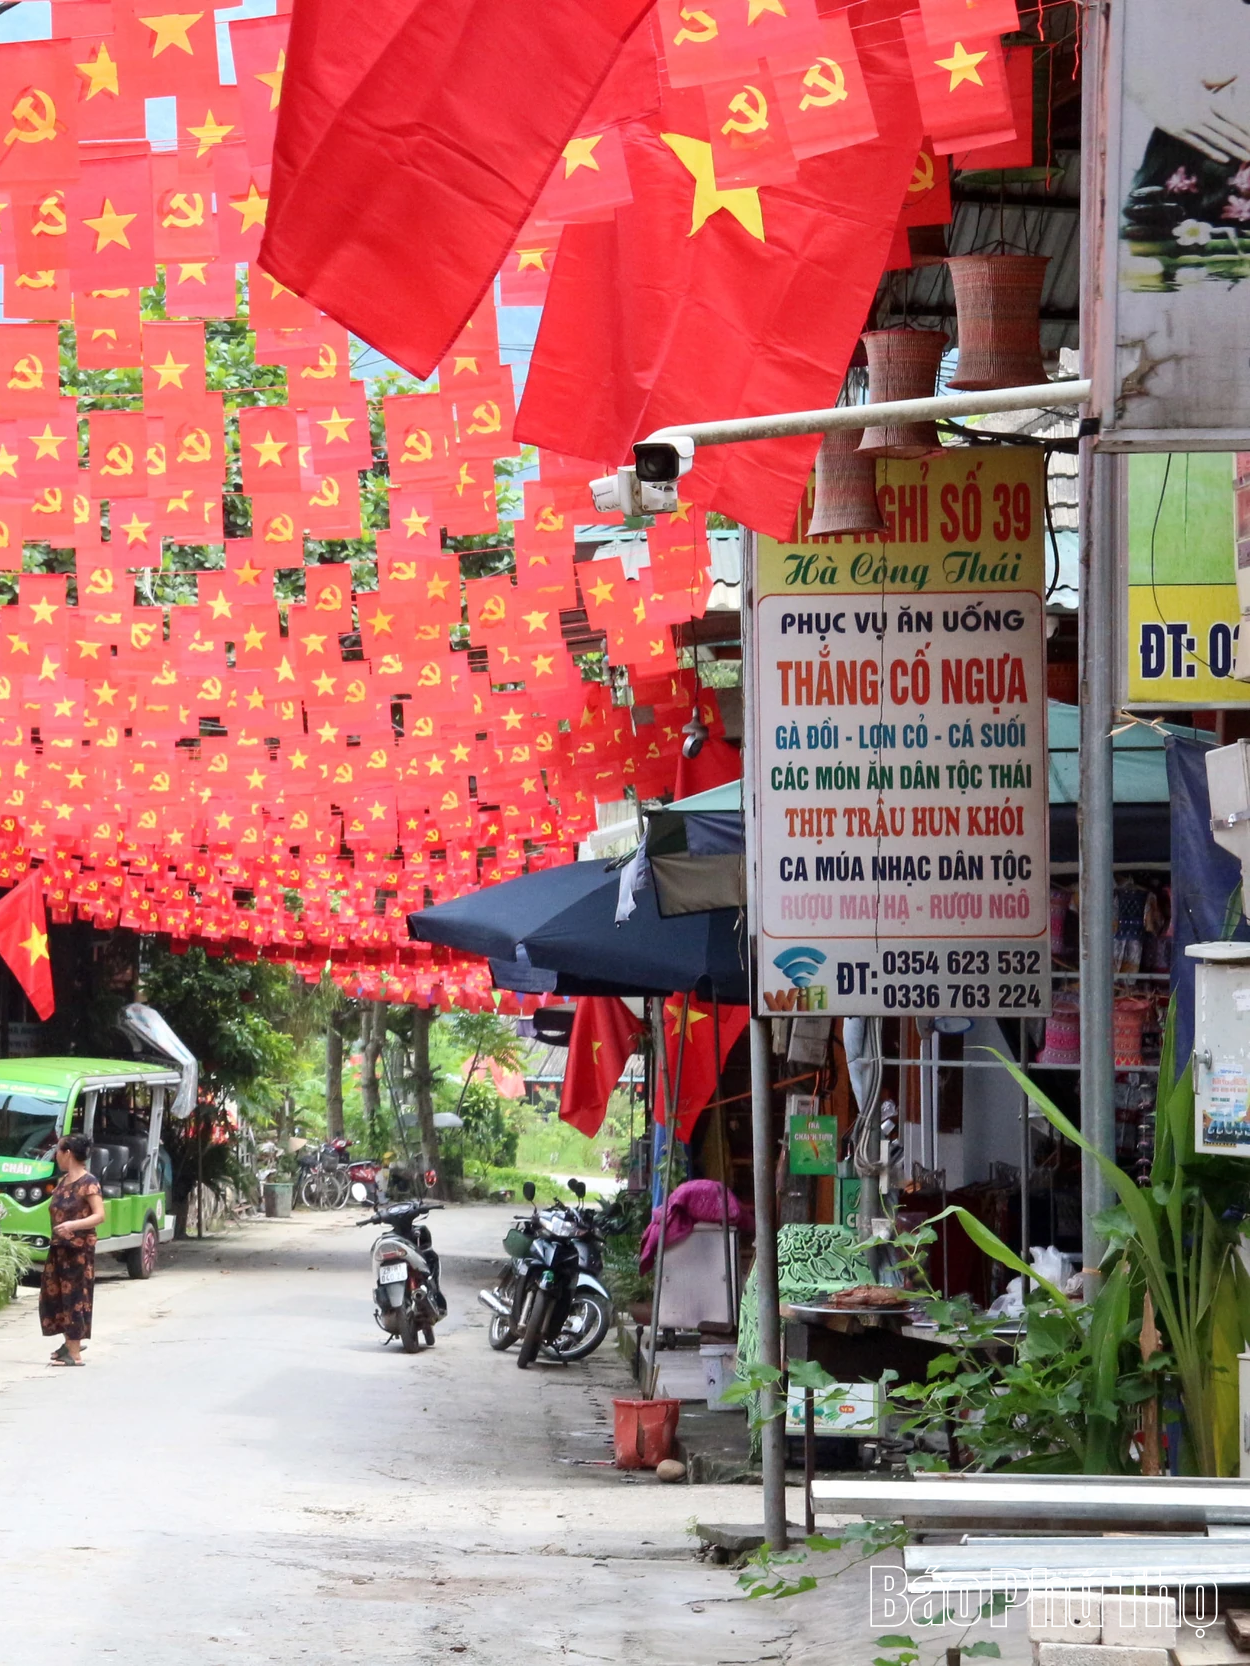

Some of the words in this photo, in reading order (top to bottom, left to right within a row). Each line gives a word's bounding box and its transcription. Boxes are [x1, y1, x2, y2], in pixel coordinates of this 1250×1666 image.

[860, 461, 929, 545] GHỈ
[940, 461, 982, 543] SỐ
[993, 482, 1031, 542] 39
[784, 553, 840, 586] Hà
[850, 552, 932, 592] Công
[943, 551, 1022, 584] Thái
[781, 612, 846, 641] PHỤC
[854, 612, 888, 641] VỤ
[898, 605, 932, 634] ĂN
[943, 601, 1025, 632] UỐNG
[1140, 623, 1196, 678] ĐT:
[776, 644, 879, 706] THẮNG
[890, 642, 931, 706] CỐ
[941, 653, 1028, 714] NGỰA
[775, 720, 801, 750] GÀ
[807, 717, 838, 750] ĐỒI
[859, 724, 896, 754] LỢN
[903, 714, 928, 748] CỎ
[949, 718, 974, 748] CÁ
[980, 715, 1026, 747] SUỐI
[771, 761, 808, 790] CÁC
[816, 761, 860, 790] MÓN
[867, 761, 893, 790] ĂN
[900, 760, 940, 789] DÂN
[946, 760, 982, 794] TỘC
[989, 760, 1032, 789] THÁI
[785, 807, 837, 845] THỊT
[843, 797, 905, 837] TRÂU
[912, 806, 960, 837] HUN
[967, 797, 1025, 836] KHÓI
[780, 857, 809, 881] CA
[816, 851, 865, 881] MÚA
[872, 855, 931, 886] NHẠC
[939, 850, 983, 880] DÂN
[991, 850, 1032, 886] TỘC
[781, 893, 833, 925] RƯỢU
[839, 895, 878, 920] MAI
[884, 895, 910, 925] HẠ
[930, 893, 983, 925] RƯỢU
[990, 889, 1030, 919] NGÔ
[837, 962, 878, 995] ĐT:
[883, 951, 939, 975] 0354
[947, 951, 990, 975] 623
[998, 951, 1041, 975] 532
[883, 984, 940, 1009] 0336
[947, 985, 990, 1009] 763
[999, 985, 1041, 1009] 224
[1, 1161, 33, 1175] CHÂU
